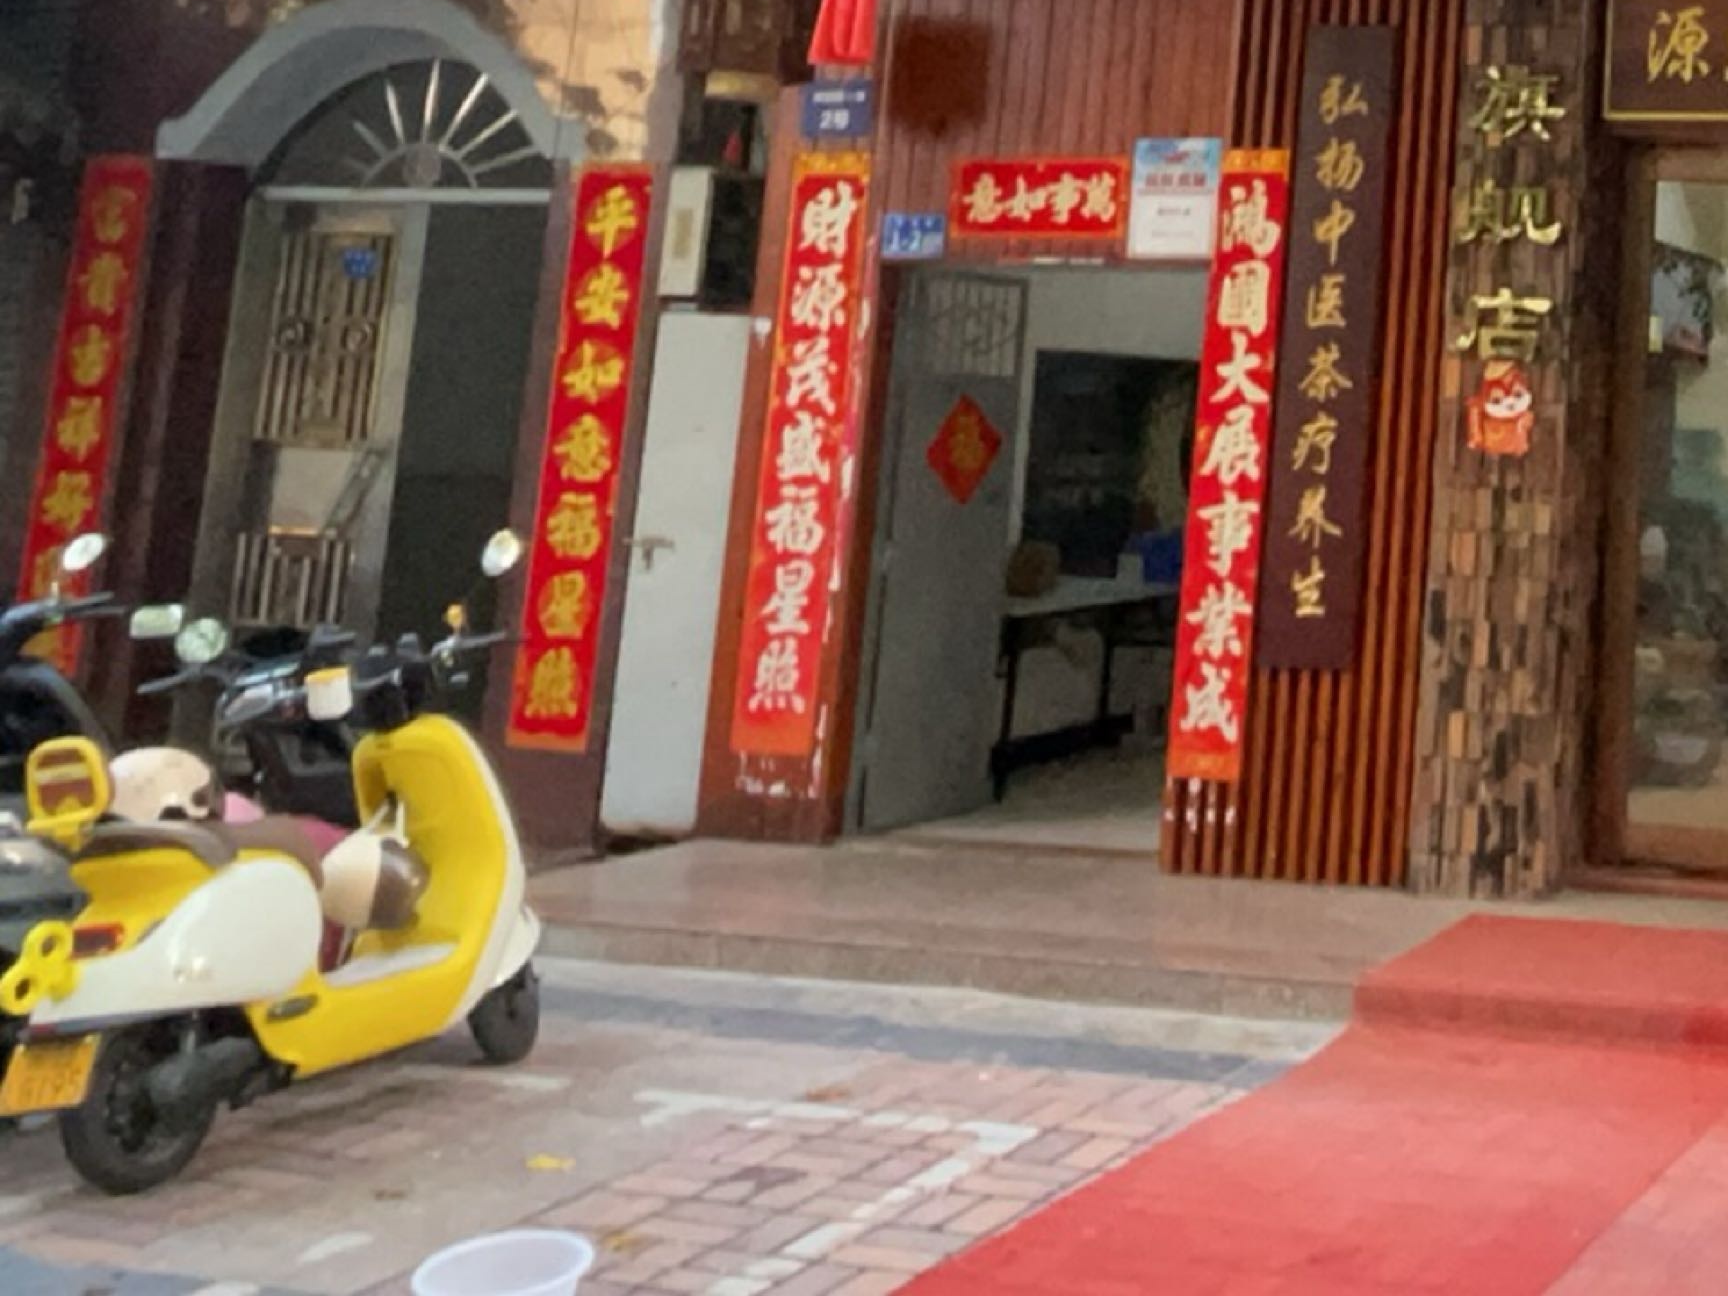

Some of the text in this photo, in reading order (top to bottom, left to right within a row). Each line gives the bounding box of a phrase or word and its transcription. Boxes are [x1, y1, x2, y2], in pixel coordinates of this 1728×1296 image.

[1289, 73, 1369, 618] 弘扬中医茶疗养生
[1455, 64, 1567, 363] 旗舰店
